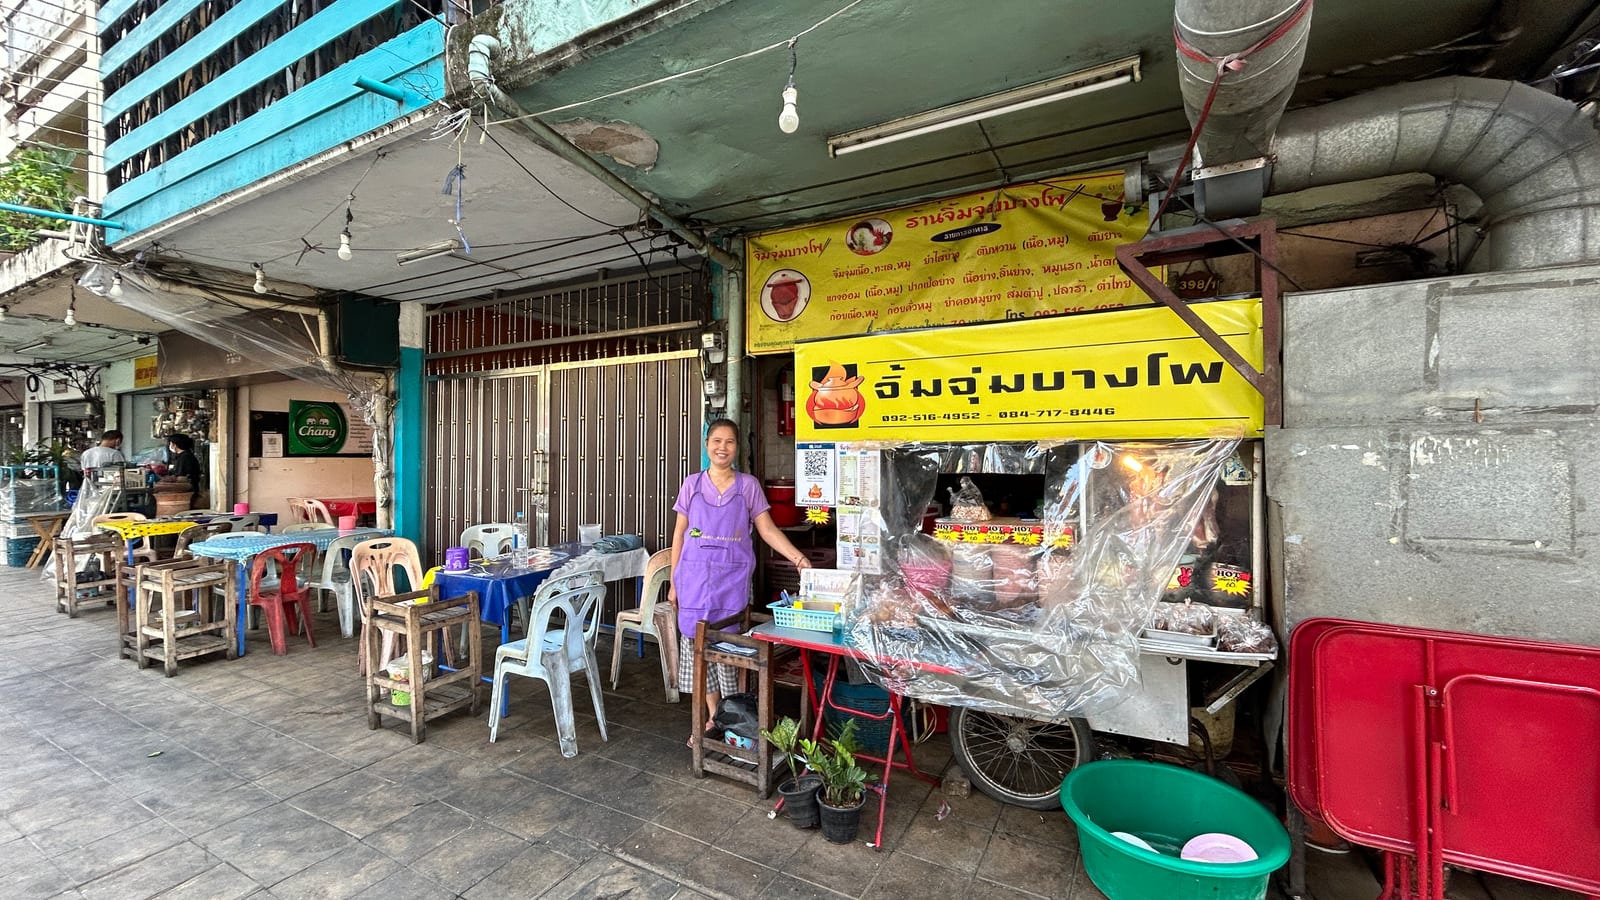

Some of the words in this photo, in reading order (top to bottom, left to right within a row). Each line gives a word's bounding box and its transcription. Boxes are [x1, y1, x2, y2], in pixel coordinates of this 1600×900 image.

[752, 239, 823, 262] จิ้มจุ่มบางโพ
[976, 242, 1017, 256] ตับหวาน
[1179, 277, 1216, 293] 398/1
[826, 289, 860, 302] แกงอ่อม
[944, 290, 1001, 308] ยำคอหมูย่าง
[874, 352, 1225, 404] จิ้มจุ่มบางโพ
[881, 412, 981, 422] 092-516-4952
[998, 407, 1116, 419] 084-717-8446
[298, 425, 337, 438] Chang
[1217, 570, 1238, 578] HOT
